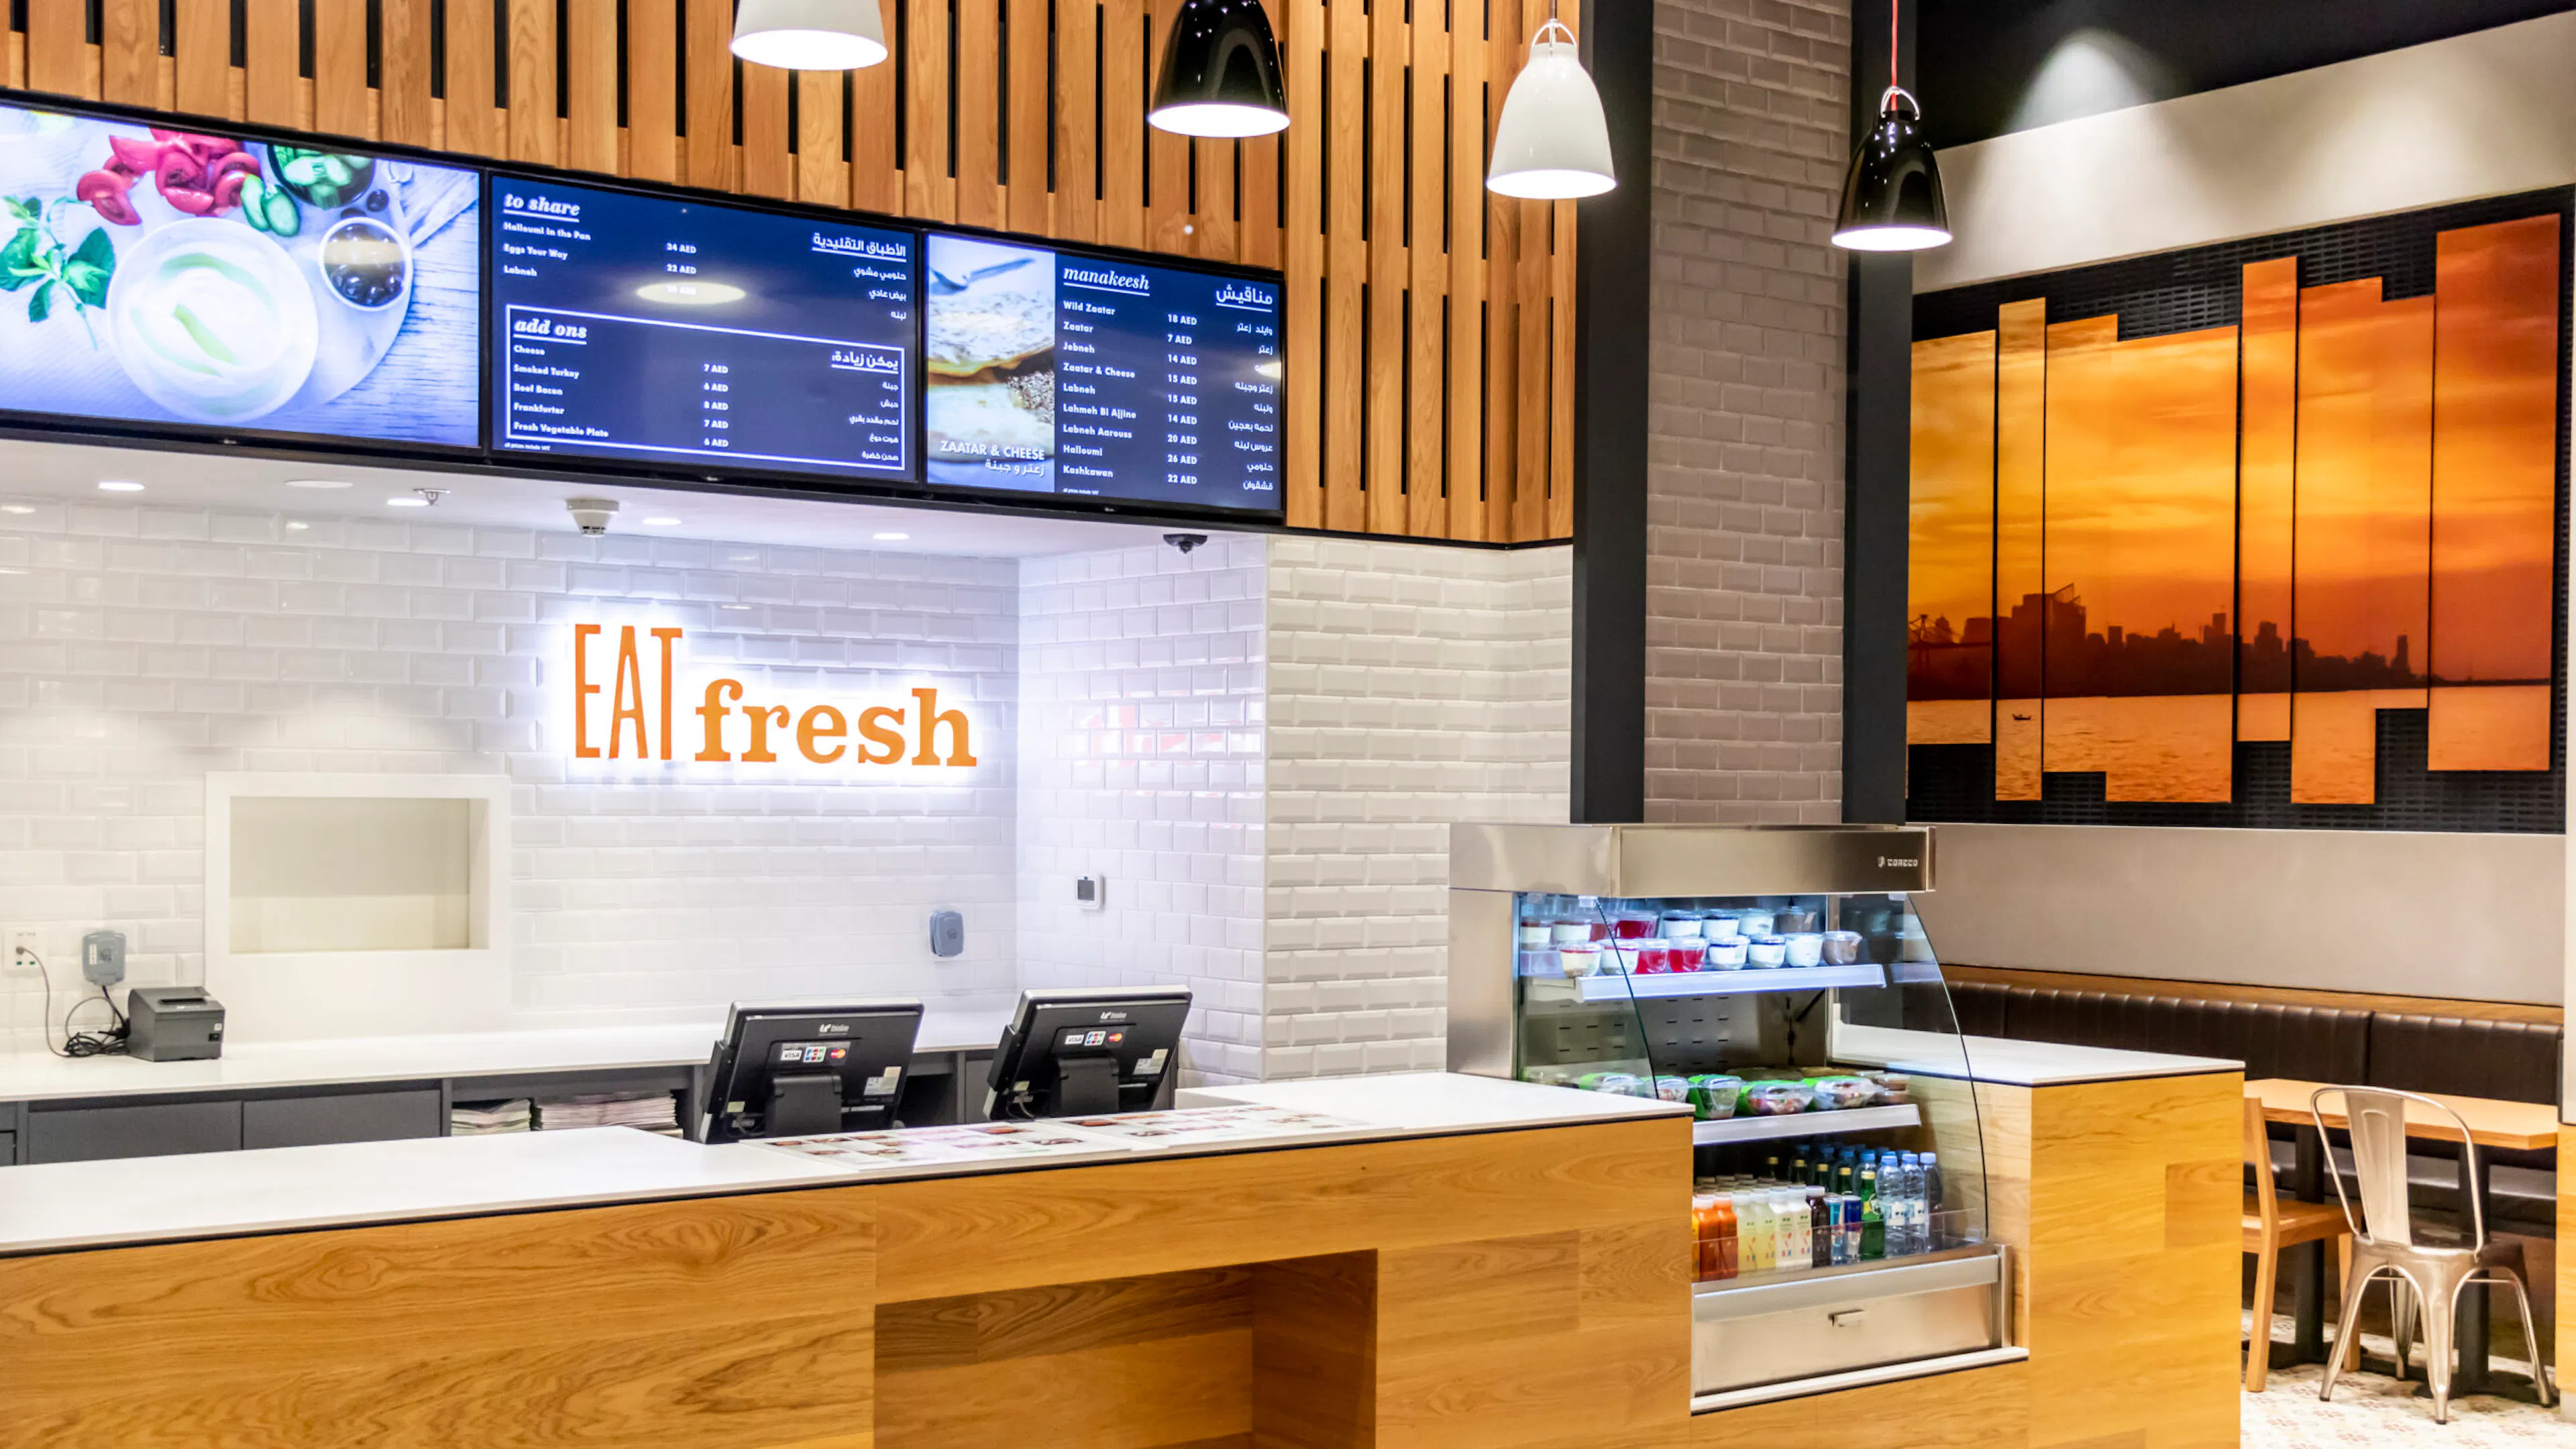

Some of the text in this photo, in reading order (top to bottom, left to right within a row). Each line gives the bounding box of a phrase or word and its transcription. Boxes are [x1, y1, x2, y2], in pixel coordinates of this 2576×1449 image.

[504, 194, 580, 215] to share
[503, 222, 591, 241] Halloumi in the Pan
[679, 244, 697, 254] AED
[812, 232, 906, 257] الأطباق التقليدية
[504, 244, 568, 260] Eggs Your Way
[504, 265, 537, 276] Labneh
[666, 264, 697, 274] 22 AED
[1063, 268, 1150, 290] manakeesh
[1216, 284, 1273, 305] مناقيش
[1063, 301, 1116, 315] Wild Zaatar
[1167, 314, 1197, 325] 18 AED
[514, 319, 588, 339] add ons
[1063, 321, 1093, 333] Zaatar
[1237, 323, 1252, 333] زعتر
[1167, 334, 1192, 345] 7 AED
[513, 344, 545, 356] Cheese
[1063, 342, 1095, 354] Jebneh
[1258, 345, 1273, 355] زعتر
[866, 354, 899, 370] يمكن
[1167, 354, 1197, 365] 14 AED
[513, 364, 580, 380] Smoked Turkey
[703, 364, 729, 374] 7 AED
[1063, 363, 1135, 378] Zaatar & Cheese
[1167, 374, 1197, 385] 15 AED
[513, 383, 564, 396] Beef Bacon
[711, 383, 729, 392] AED
[1063, 383, 1095, 394] Labneh
[1258, 384, 1273, 394] زعتر
[1167, 394, 1197, 405] 15 AED
[513, 402, 565, 415] Frankfurter
[711, 402, 729, 411] AED
[1063, 404, 1136, 419] Lahmeh Bi Ajjine
[703, 419, 729, 429] 7 AED
[1167, 415, 1197, 425] 14 AED
[513, 421, 609, 437] Fresh Vegetable Plate
[1063, 424, 1132, 439] Labneh Aarouss
[711, 438, 729, 448] AED
[1167, 434, 1197, 445] 20 AED
[940, 440, 1045, 461] ZAATAR & CHEESE
[1063, 445, 1103, 456] Halloumi
[1167, 454, 1197, 465] 26 AED
[985, 458, 1011, 473] جبنة
[1021, 464, 1044, 476] زعتر
[1246, 462, 1273, 473] حلومي
[1063, 466, 1114, 478] Kashkawan
[1167, 474, 1197, 485] 22 AED
[575, 624, 977, 767] EAT fresh
[784, 1051, 800, 1059] VISA
